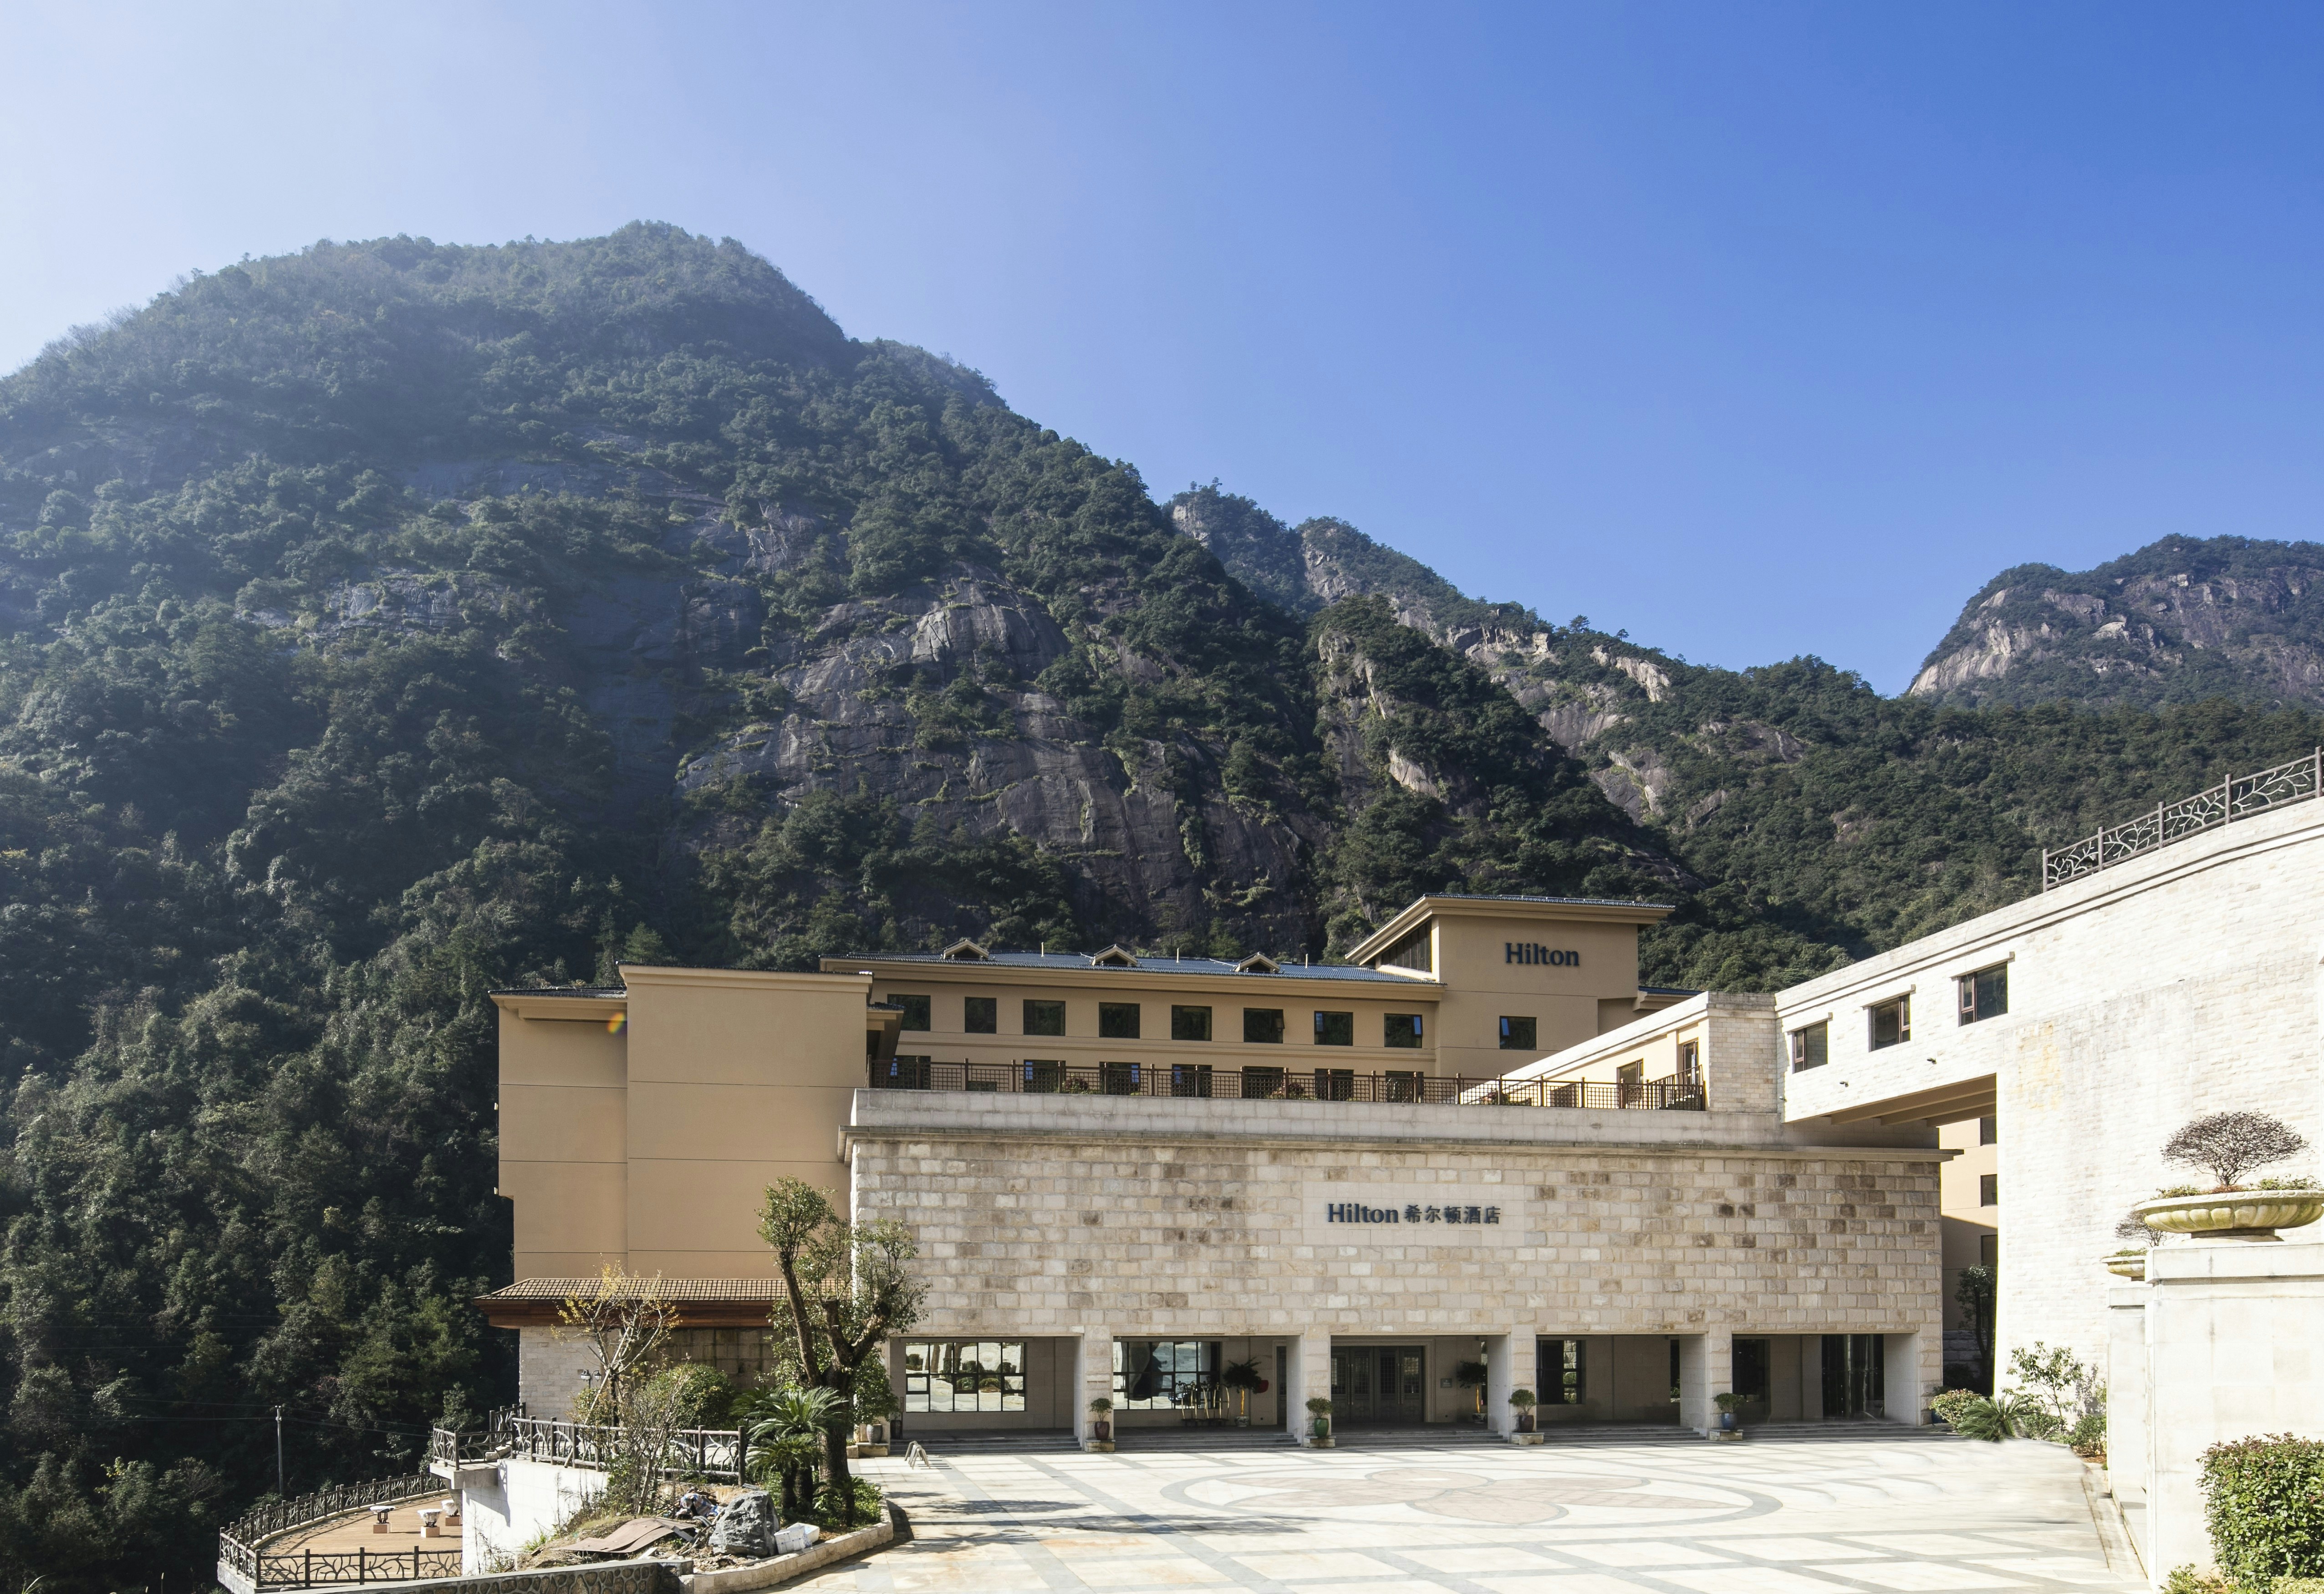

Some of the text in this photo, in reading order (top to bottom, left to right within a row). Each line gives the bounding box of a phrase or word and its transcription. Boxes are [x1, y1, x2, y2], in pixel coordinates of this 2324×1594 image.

[1505, 943, 1580, 966] Hilton
[1328, 1203, 1501, 1224] Hilton 希尔顿酒店
